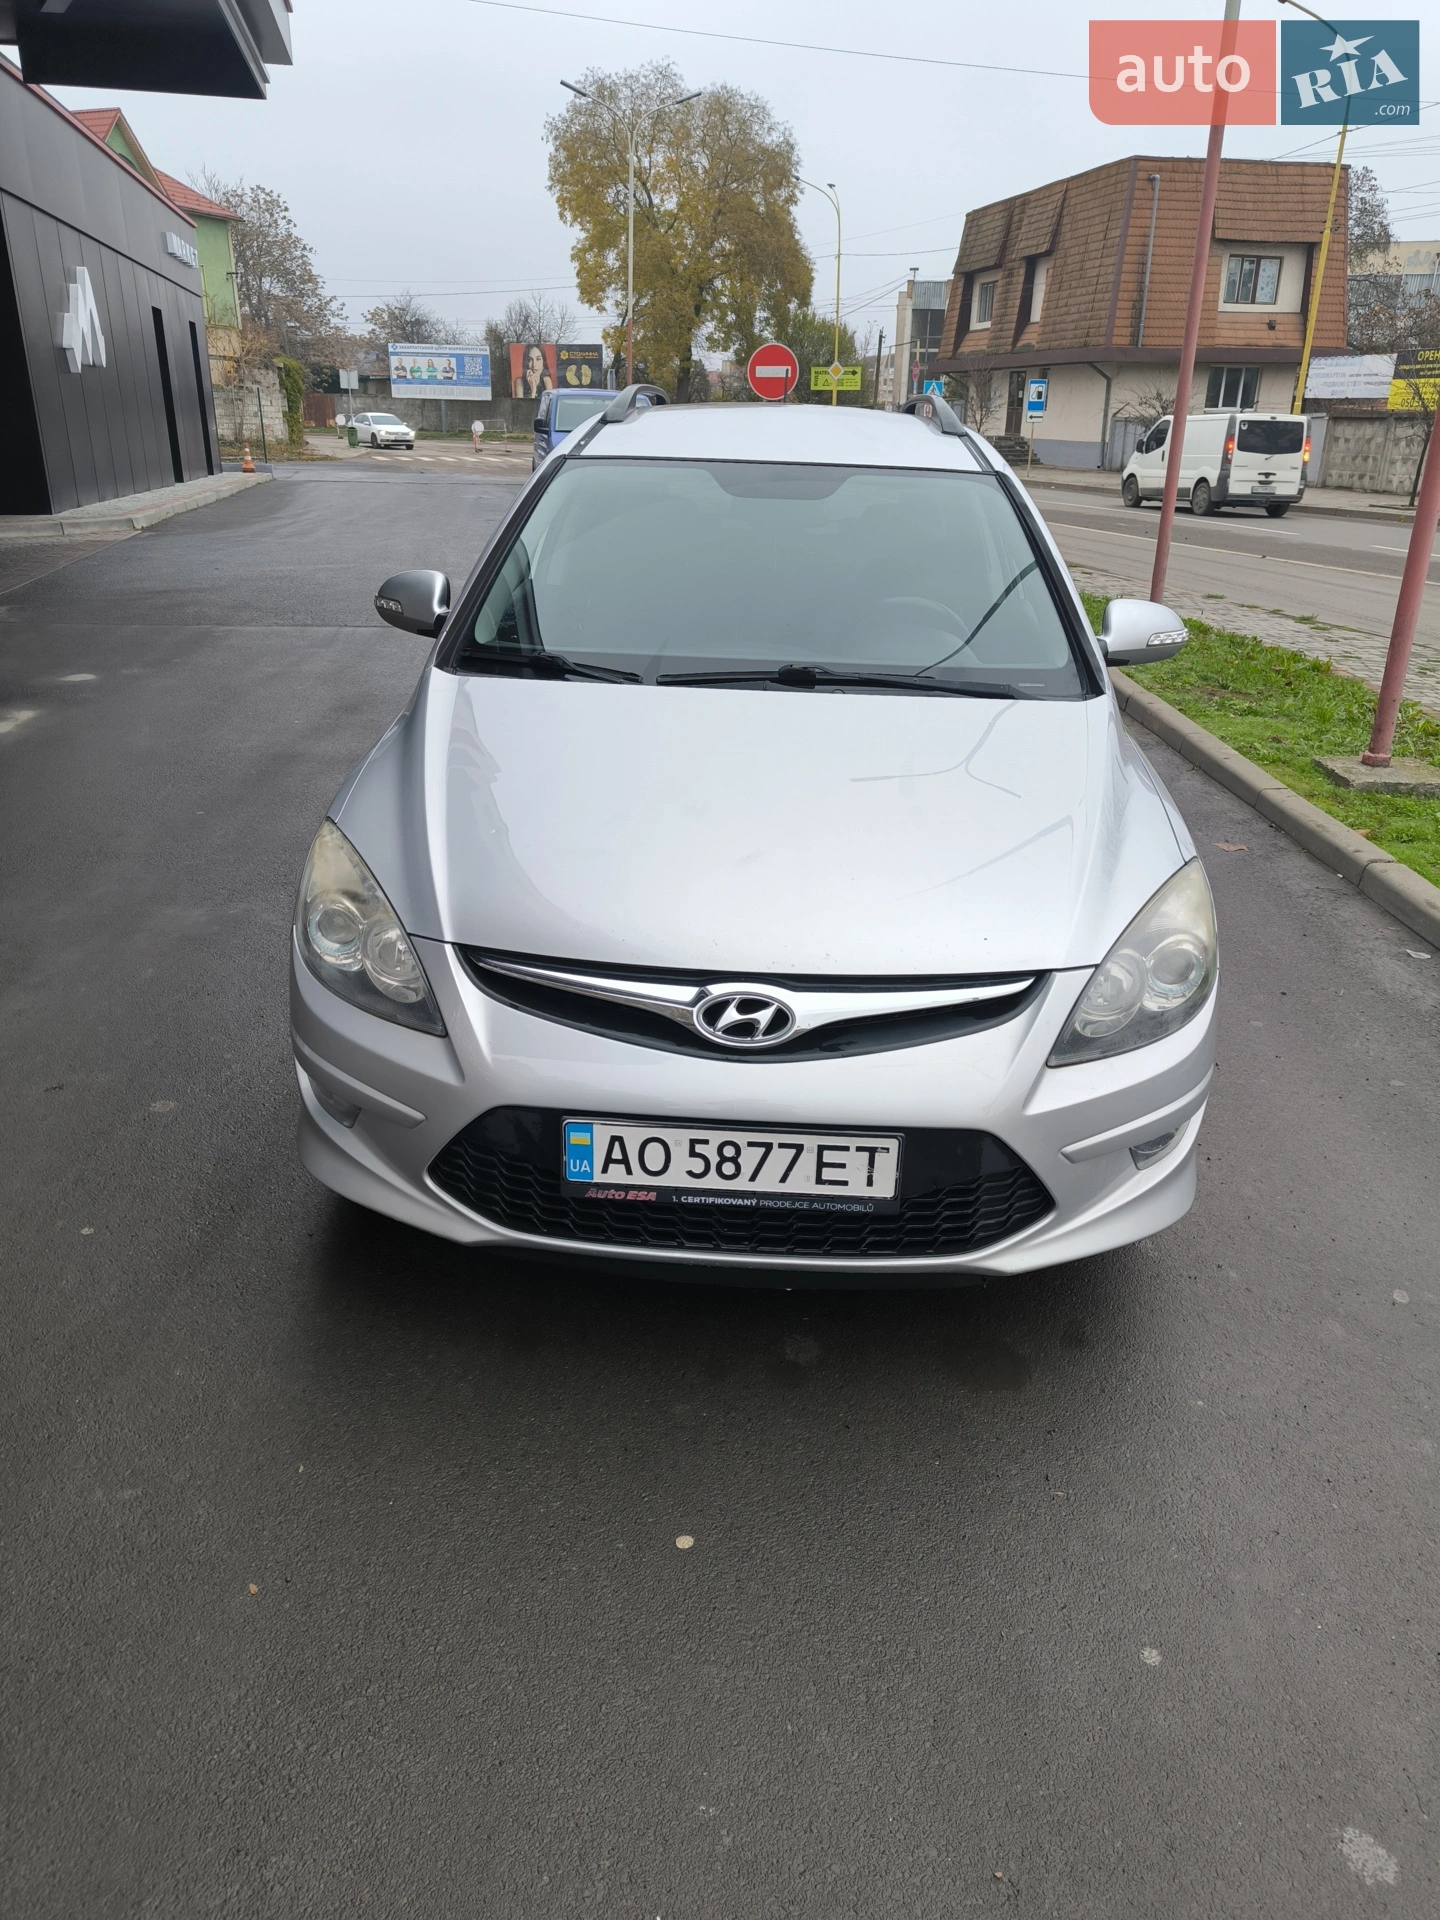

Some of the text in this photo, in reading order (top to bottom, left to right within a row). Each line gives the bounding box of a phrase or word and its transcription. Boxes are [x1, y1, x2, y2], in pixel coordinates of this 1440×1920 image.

[569, 1159, 591, 1173] UA
[600, 1134, 890, 1187] AO 5877 ET
[585, 1188, 657, 1201] Auto ESA
[681, 1196, 758, 1207] CERTIFIKOVANÝ
[759, 1199, 810, 1209] PRODEJCE
[811, 1202, 874, 1213] AUTOMOBILŮ
